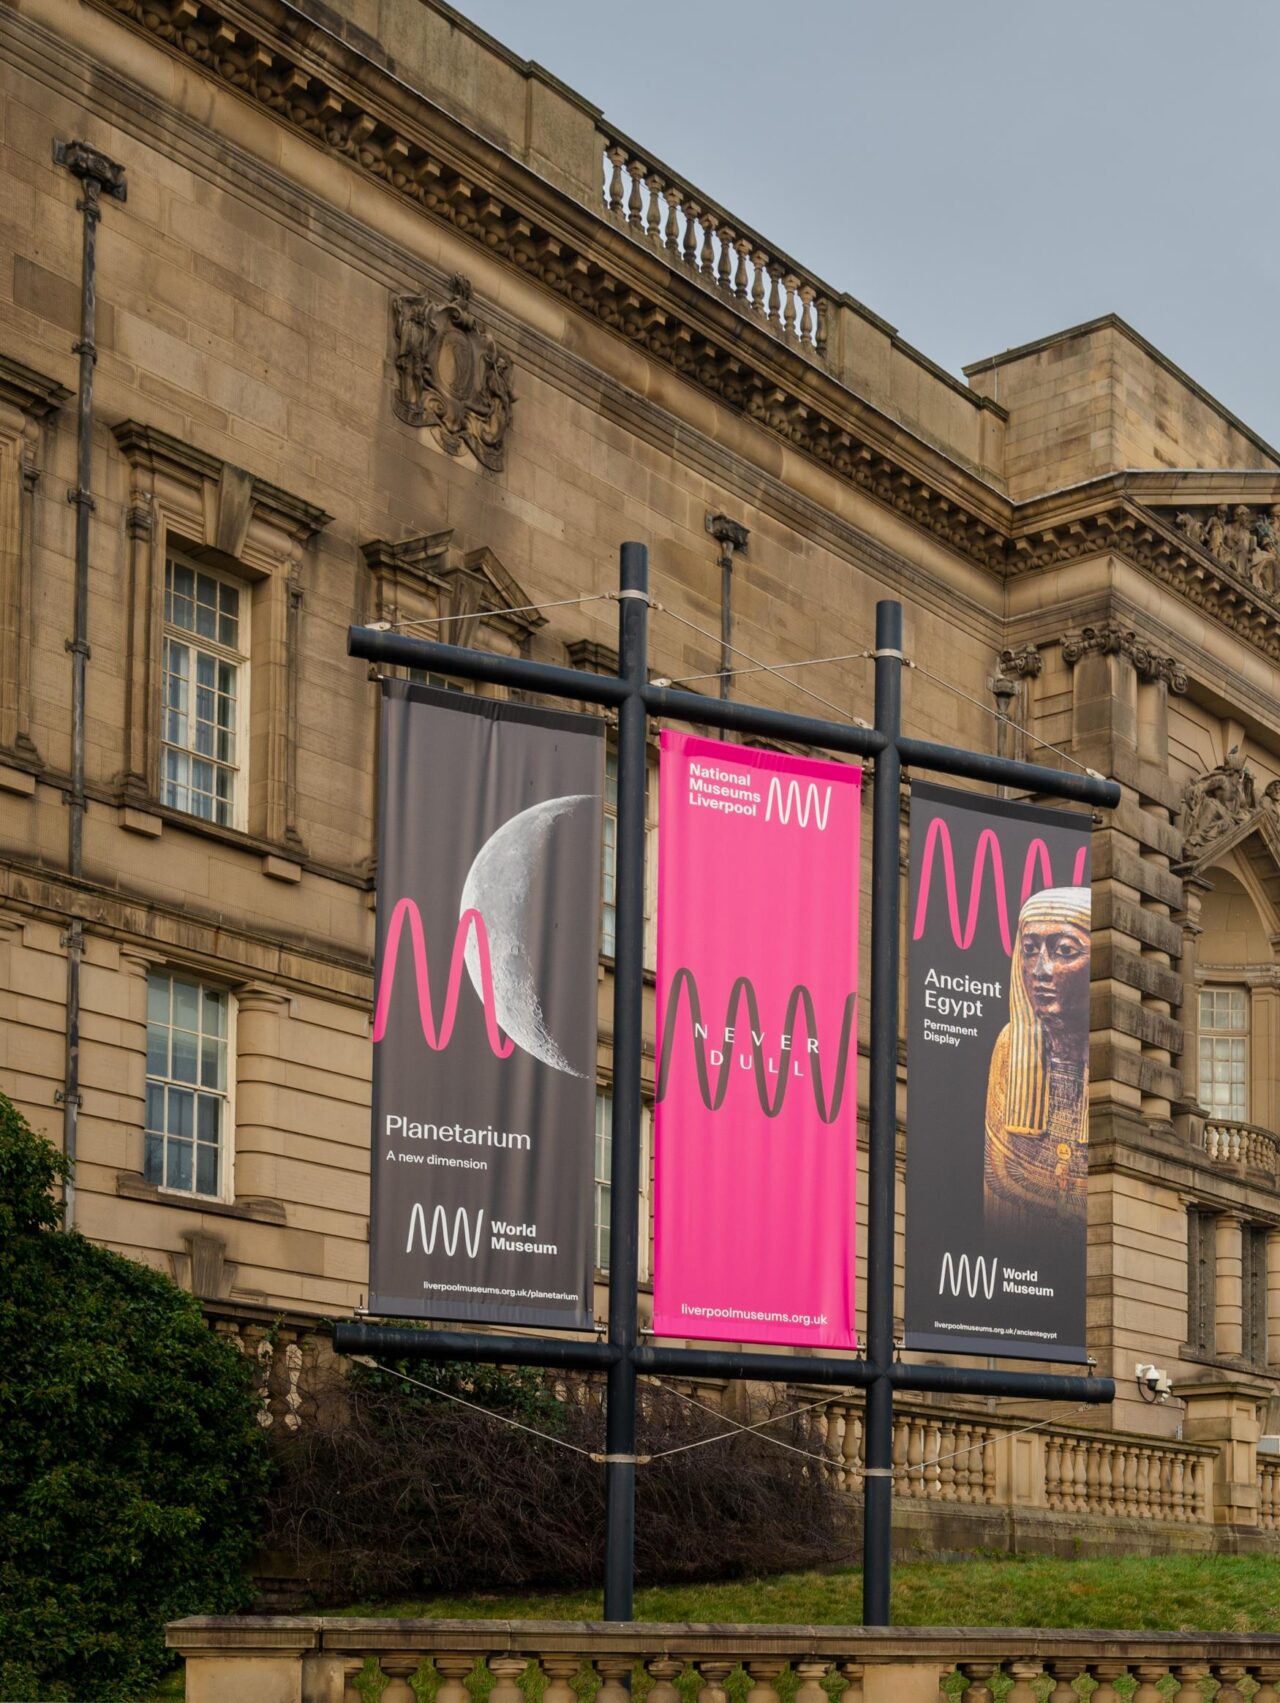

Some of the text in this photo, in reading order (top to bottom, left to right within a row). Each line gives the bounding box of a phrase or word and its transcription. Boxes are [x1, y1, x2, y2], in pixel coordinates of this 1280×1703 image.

[690, 763, 751, 787] National
[690, 778, 761, 803] Museums
[689, 792, 757, 816] Liverpool
[924, 968, 1002, 999] Ancient
[924, 990, 983, 1019] Egypt
[694, 1023, 819, 1054] NEVER
[924, 1019, 978, 1037] Permanent
[924, 1031, 961, 1047] Display
[710, 1050, 804, 1077] DULL
[386, 1115, 531, 1150] Planetarium
[386, 1150, 488, 1170] A new dimension
[491, 1220, 537, 1237] World
[491, 1237, 558, 1255] Museum
[1003, 1267, 1038, 1282] World
[423, 1281, 579, 1301] liverpoolmuseums.org.uk/planetarium
[1003, 1281, 1054, 1297] Museum
[681, 1303, 828, 1326] liverpoolmuseums.org.uk
[934, 1321, 1058, 1339] liverpoolmuseums.org.uk/ancientegypt
